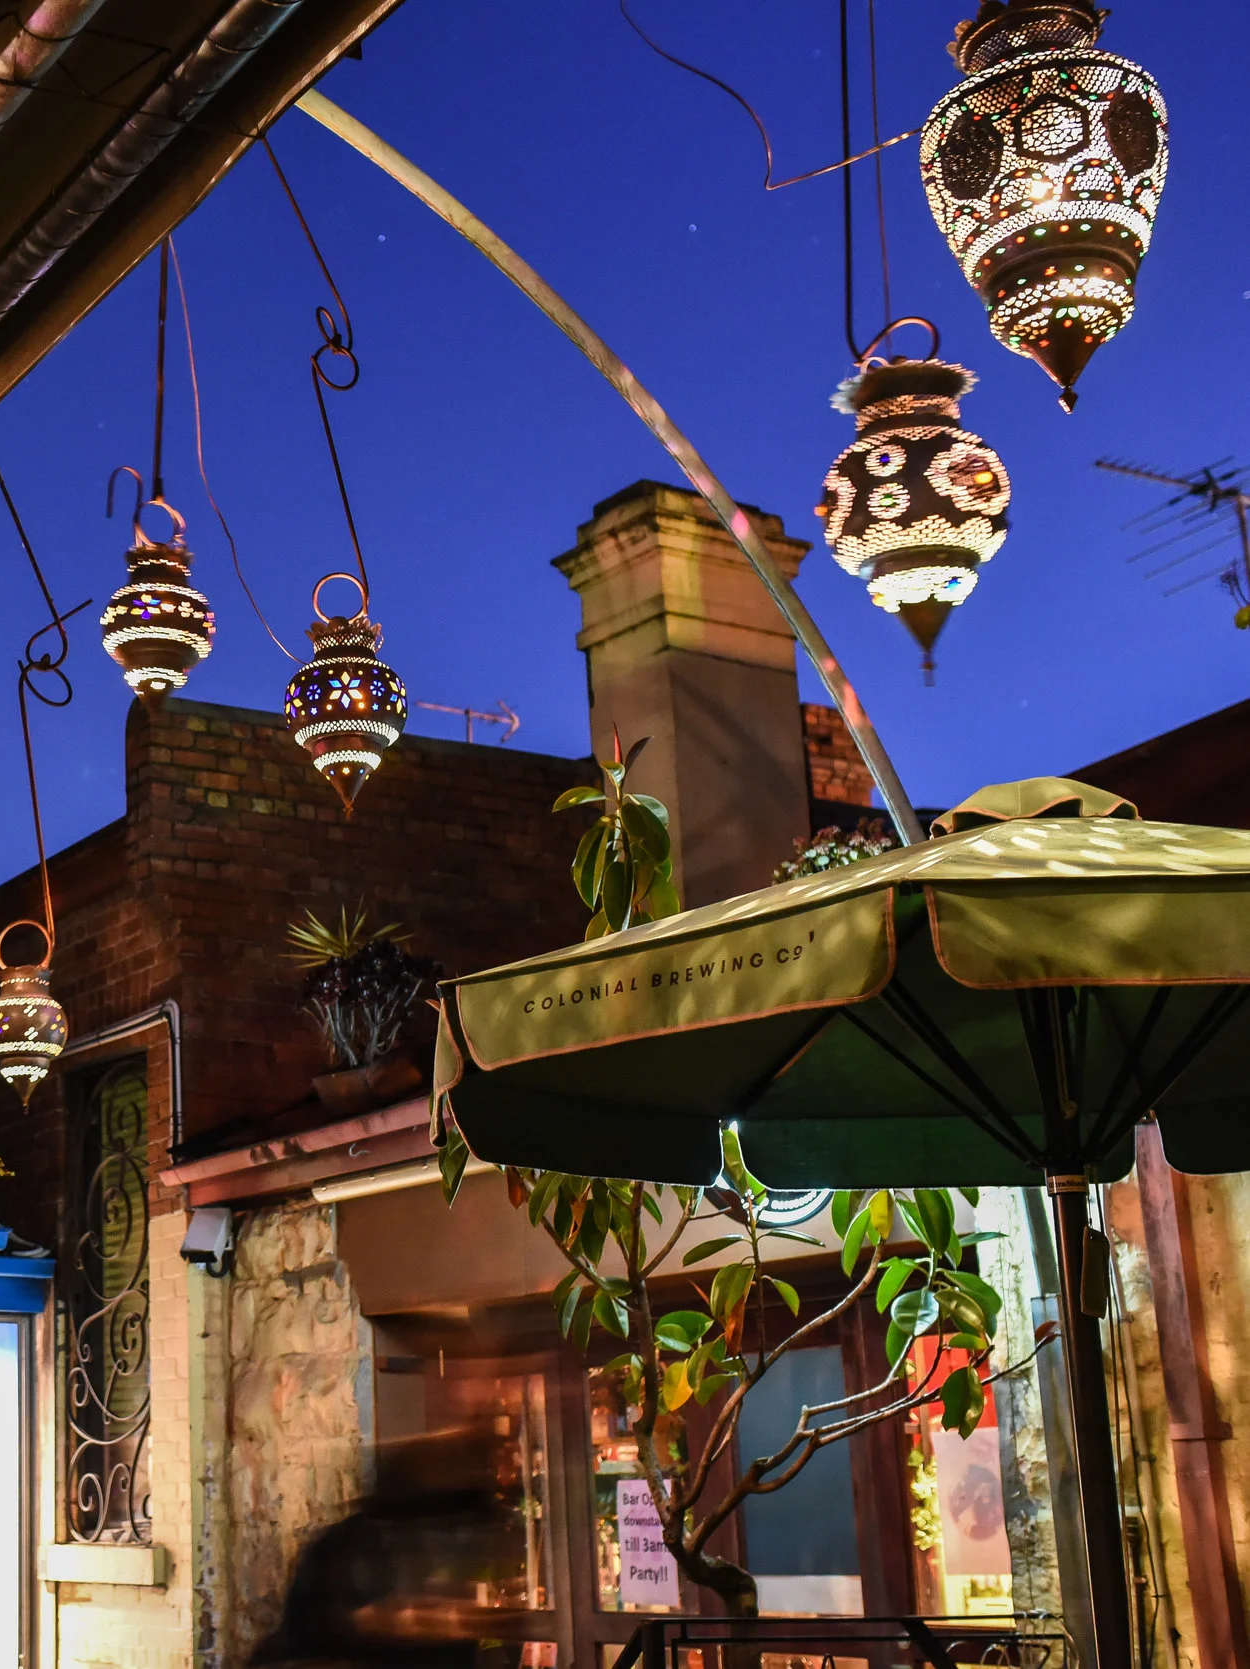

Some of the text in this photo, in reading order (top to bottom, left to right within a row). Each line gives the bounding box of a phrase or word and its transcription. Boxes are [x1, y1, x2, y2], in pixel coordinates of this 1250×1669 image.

[523, 978, 638, 1014] COLONIAL
[651, 951, 764, 987] BREWING
[622, 1492, 655, 1507] Bar Op
[623, 1516, 661, 1527] downsta
[625, 1537, 639, 1552] till
[630, 1565, 668, 1585] Party!!
